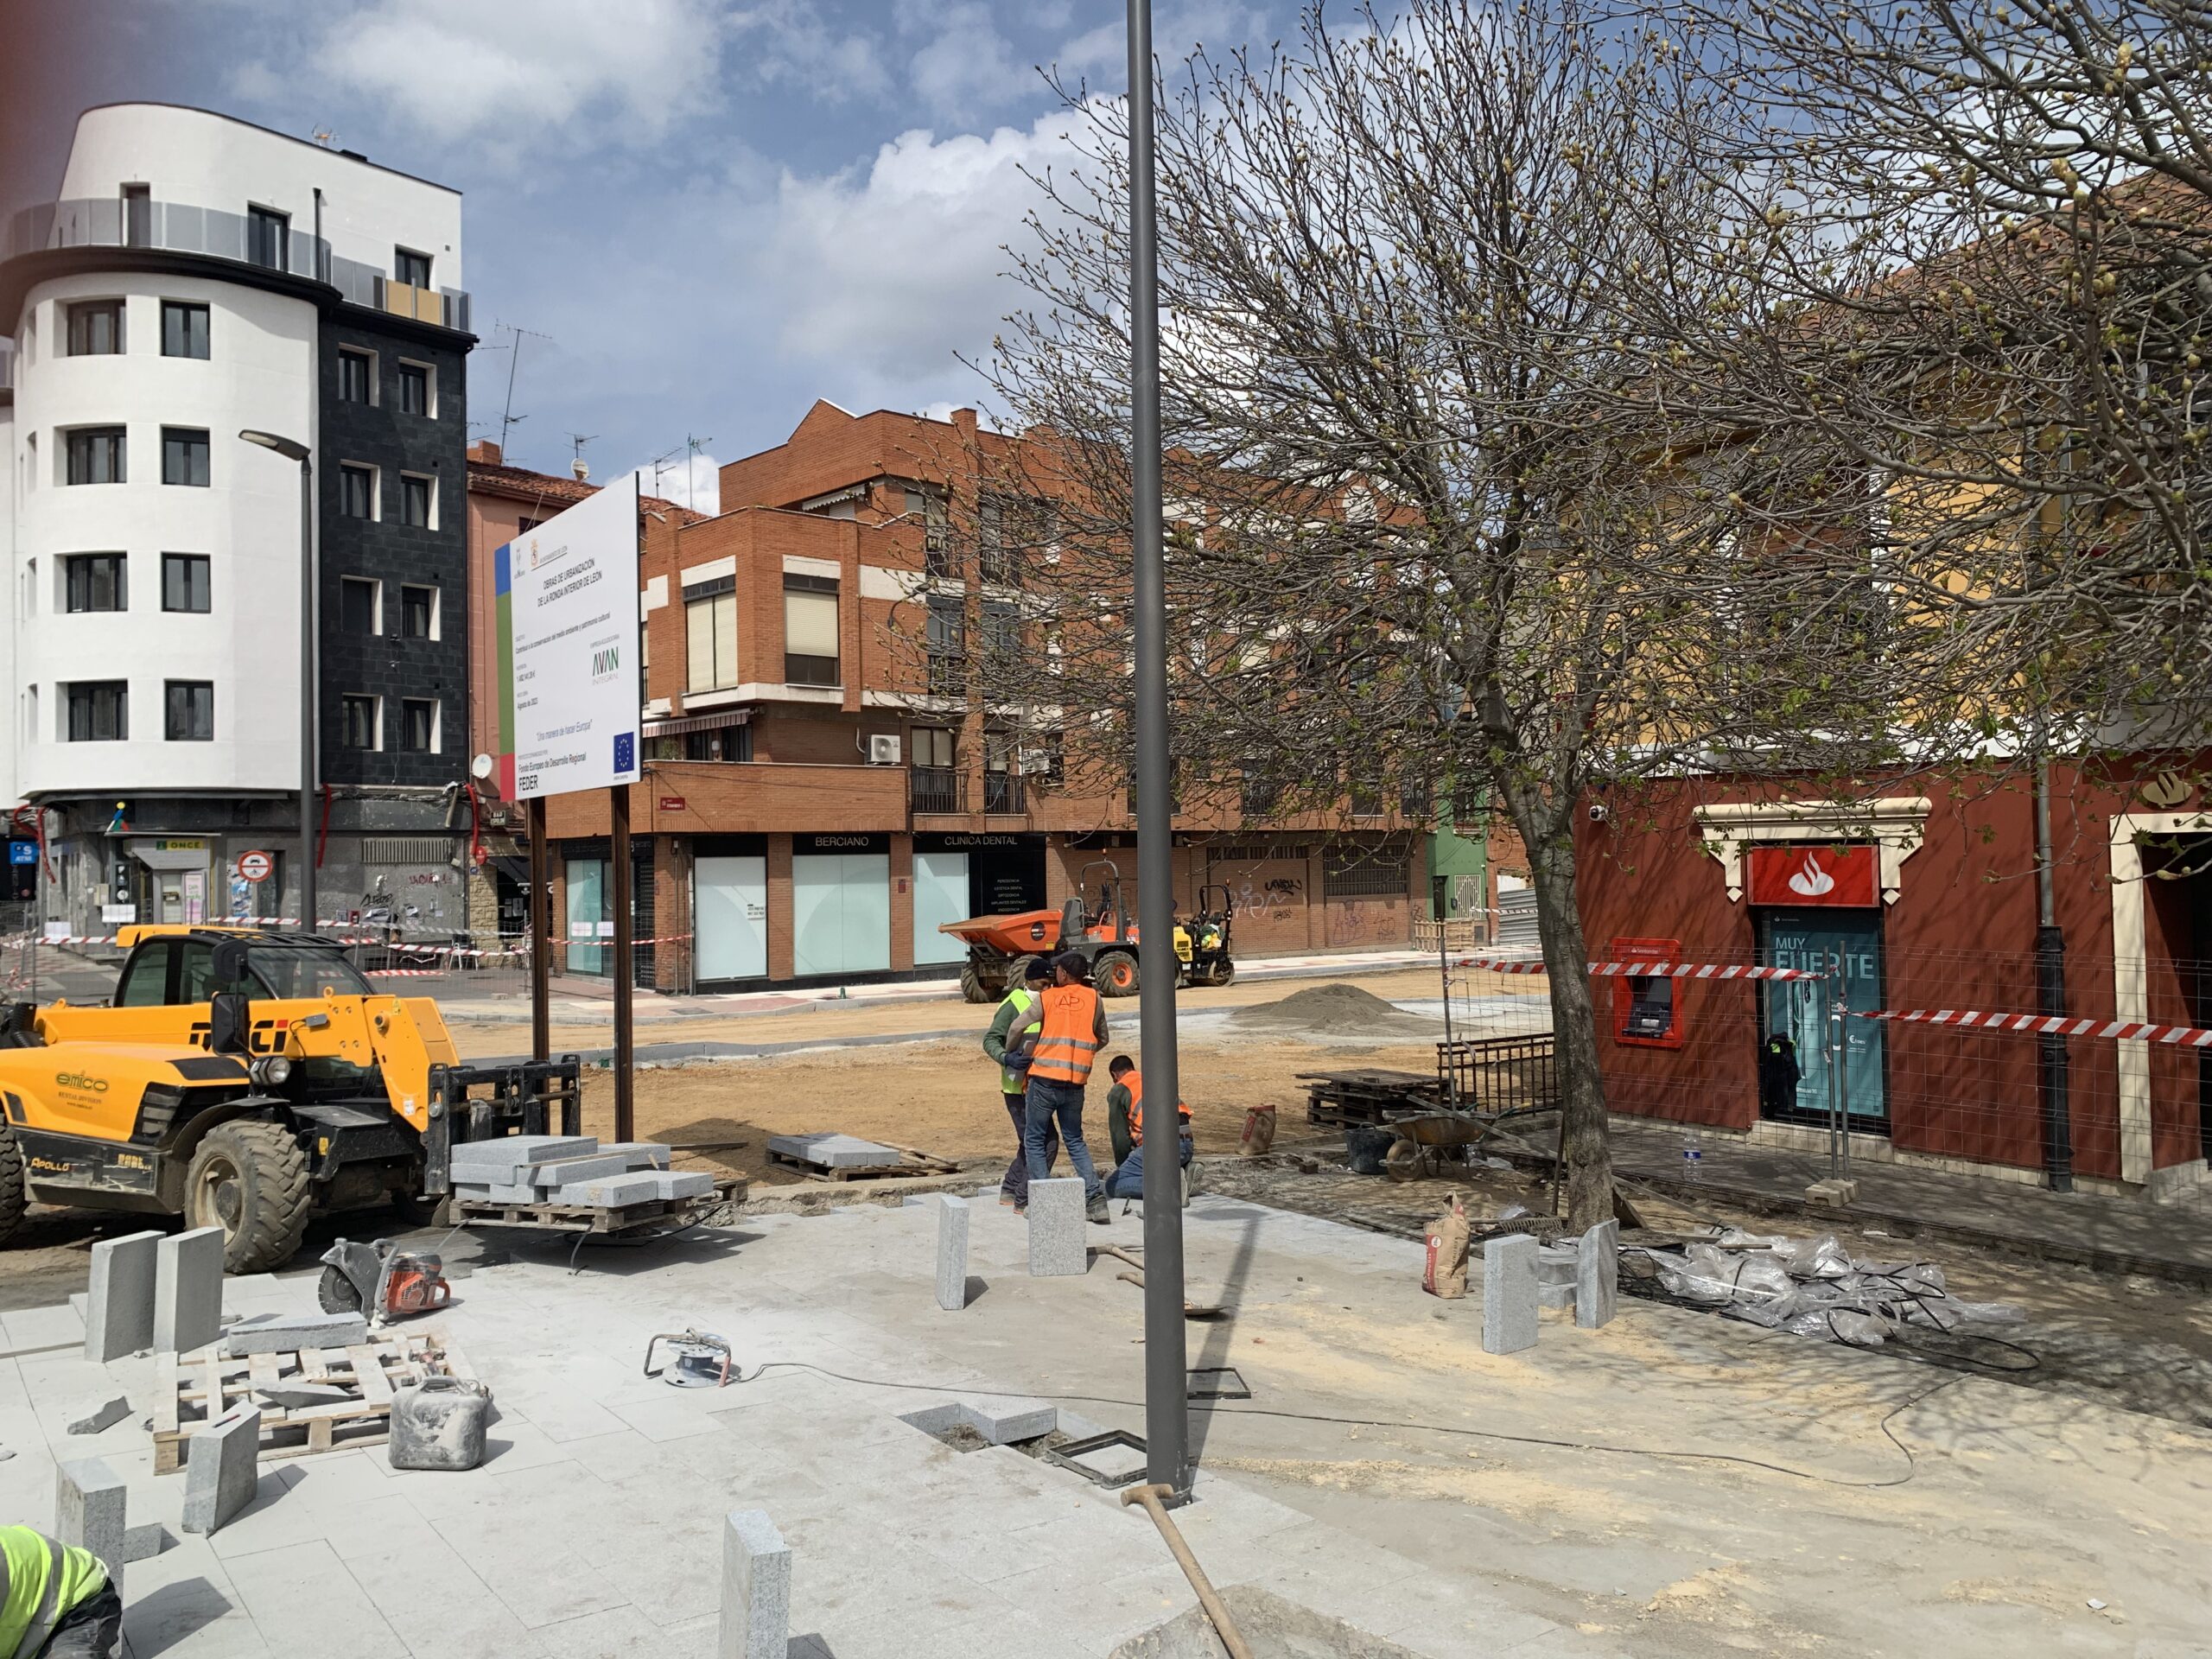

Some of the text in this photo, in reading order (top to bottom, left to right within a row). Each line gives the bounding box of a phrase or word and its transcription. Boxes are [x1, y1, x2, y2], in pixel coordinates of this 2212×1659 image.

[543, 557, 594, 590] OBRAS DE URBANIZACIÓN
[537, 569, 602, 607] DE LA RONDA INTERIOR DE LEÓN
[593, 646, 619, 677] AVAN
[593, 673, 619, 686] INTEGRAL
[545, 728, 558, 739] manera
[559, 728, 564, 736] de
[565, 725, 575, 734] hacer
[518, 751, 587, 774] Fondo Europeo de Desarrollo Regional
[518, 774, 538, 791] FEDER
[815, 836, 869, 847] BERCIANO
[983, 836, 1018, 845] DENTAL
[1776, 937, 1806, 950] MUY
[1776, 950, 1875, 980] FUERTE
[56, 1072, 109, 1092] emico
